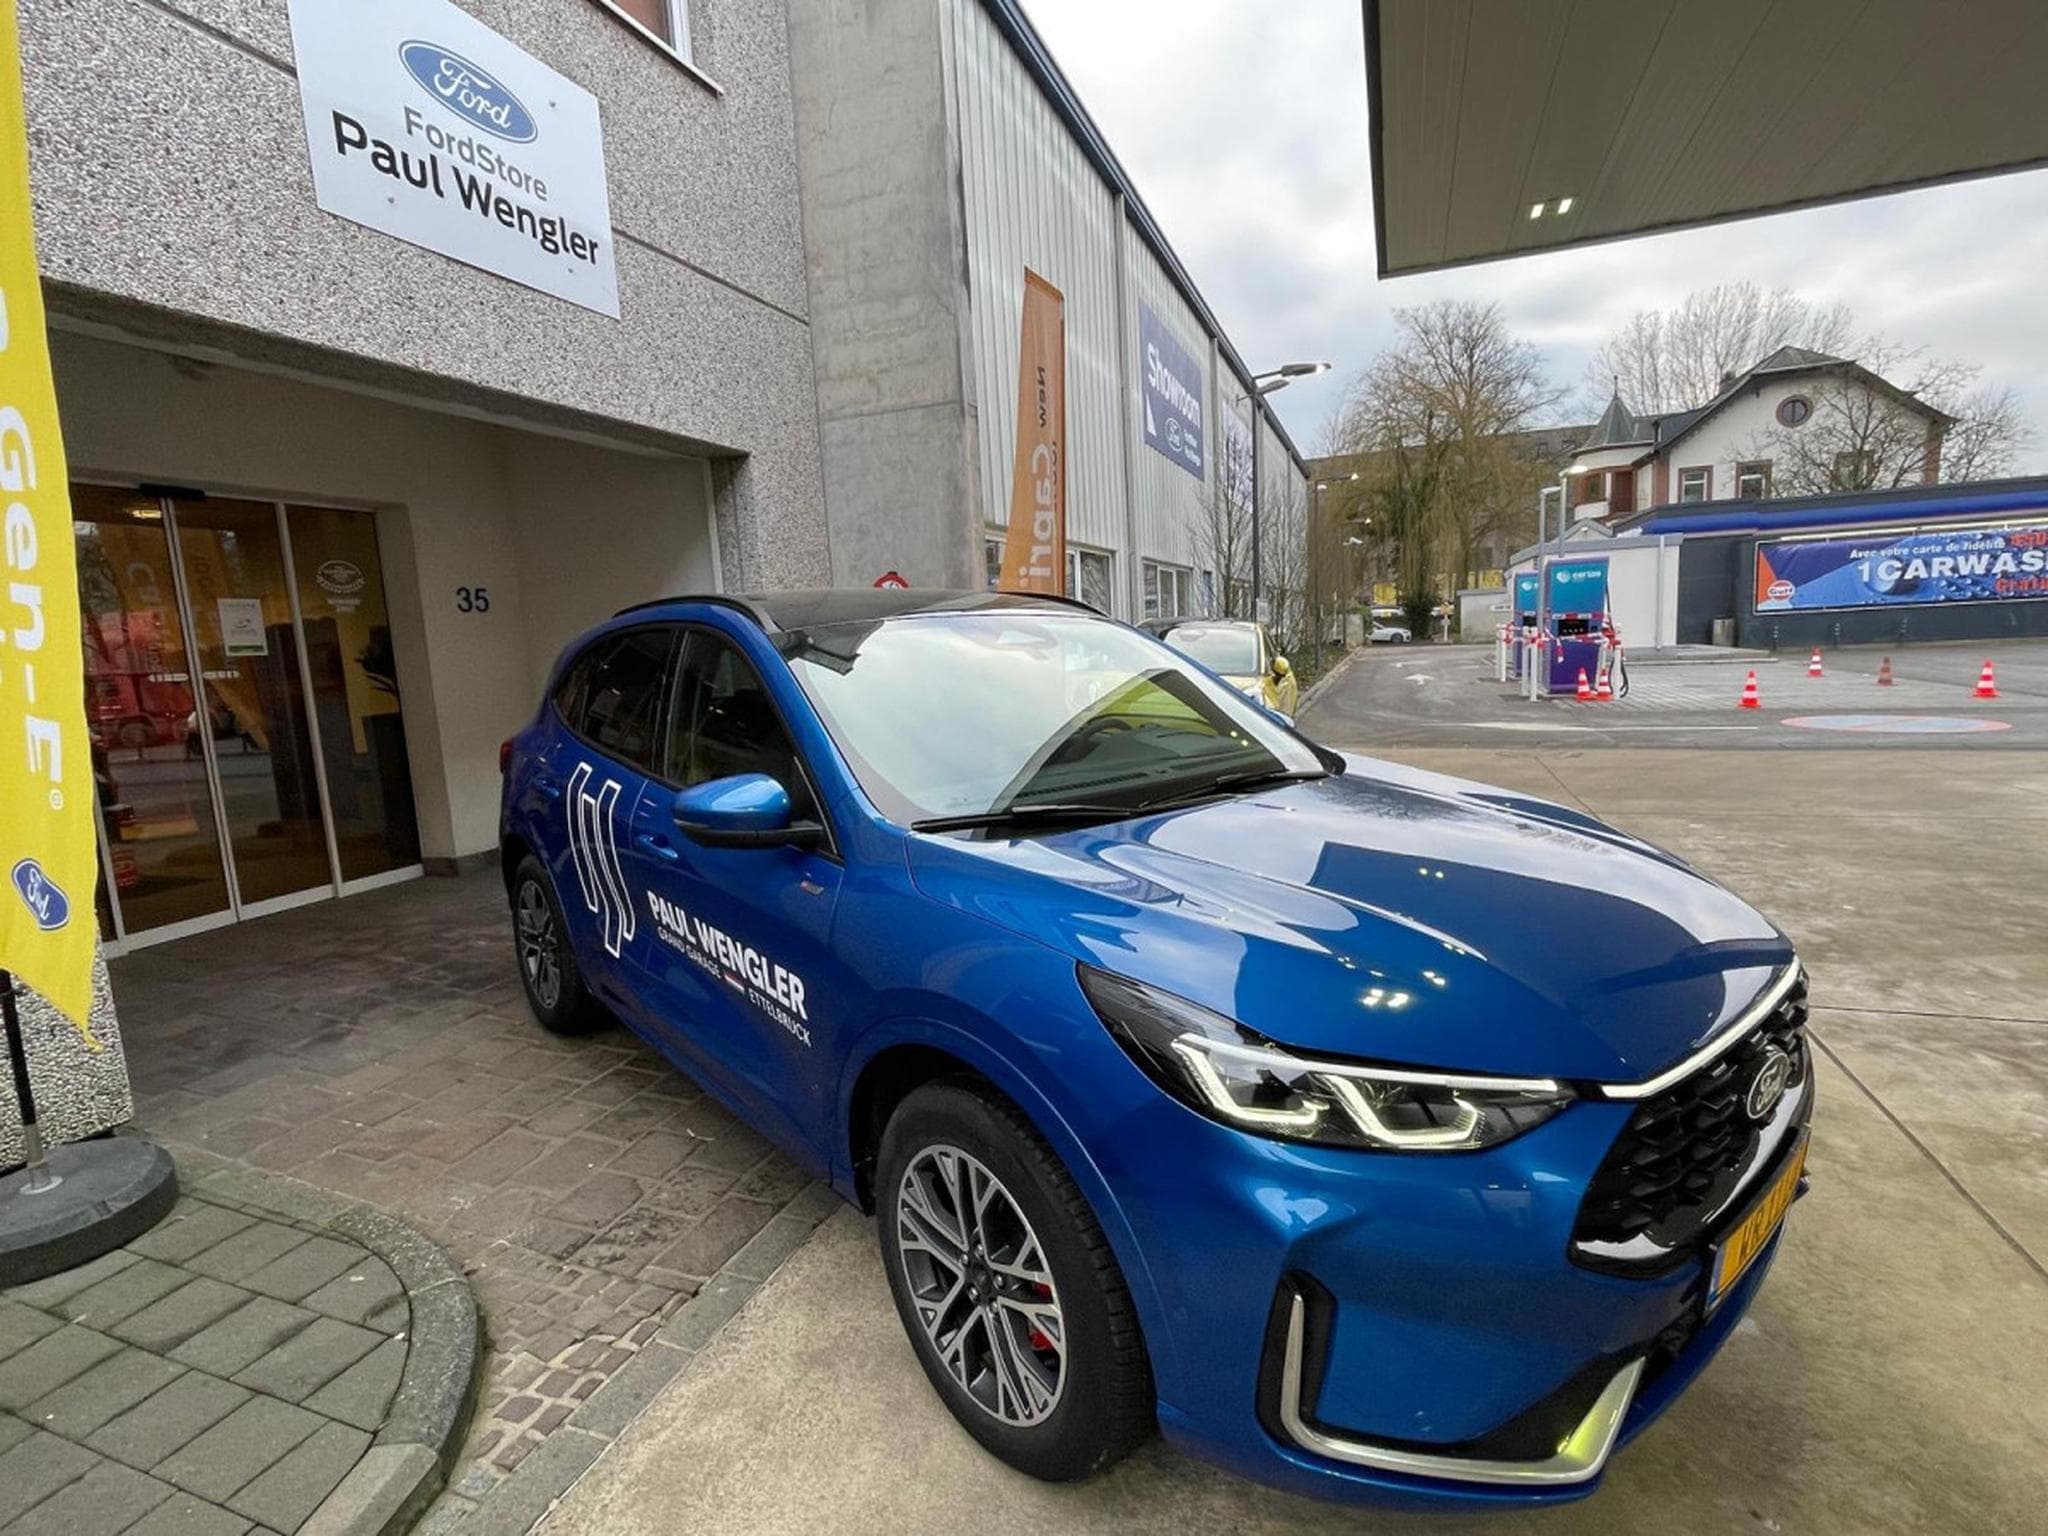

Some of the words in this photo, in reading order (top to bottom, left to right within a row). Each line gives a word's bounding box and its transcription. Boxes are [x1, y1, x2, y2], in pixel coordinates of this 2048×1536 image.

[434, 58, 511, 129] Ford
[332, 110, 444, 198] Paul
[451, 165, 598, 265] Wengler
[403, 106, 548, 202] FordStore
[1148, 342, 1201, 428] Showroom
[1850, 548, 1877, 559] Avec
[1880, 547, 1909, 557] votre
[1912, 544, 1942, 555] carte
[1946, 542, 1960, 552] de
[1877, 550, 2048, 580] CARWAS
[456, 586, 489, 613] 35
[647, 889, 697, 945] PAUL
[694, 916, 809, 1021] WENGLER
